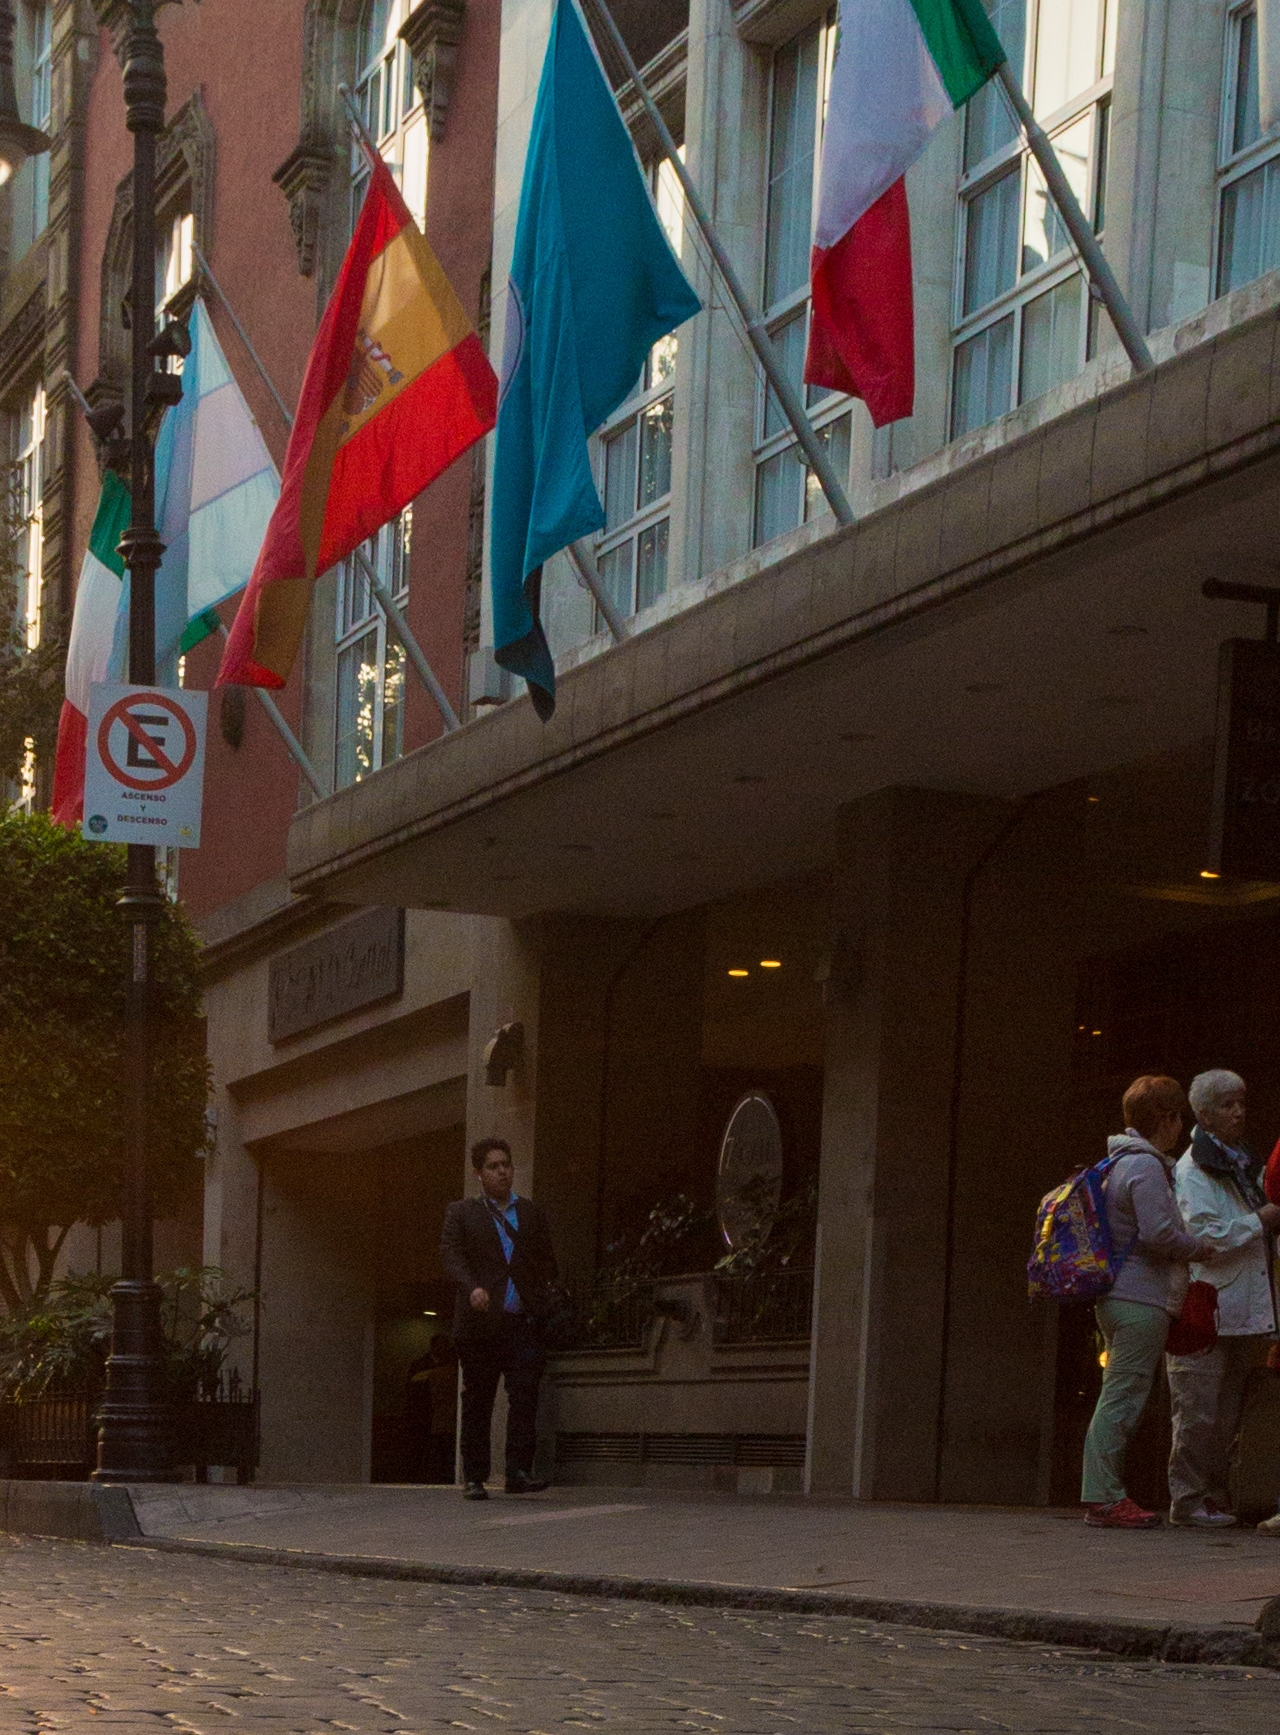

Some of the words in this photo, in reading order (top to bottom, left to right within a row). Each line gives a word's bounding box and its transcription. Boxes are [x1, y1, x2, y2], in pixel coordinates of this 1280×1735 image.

[127, 714, 169, 769] E
[121, 791, 166, 803] ASCENSO
[140, 804, 147, 812] Y
[117, 814, 168, 826] DESCENSO
